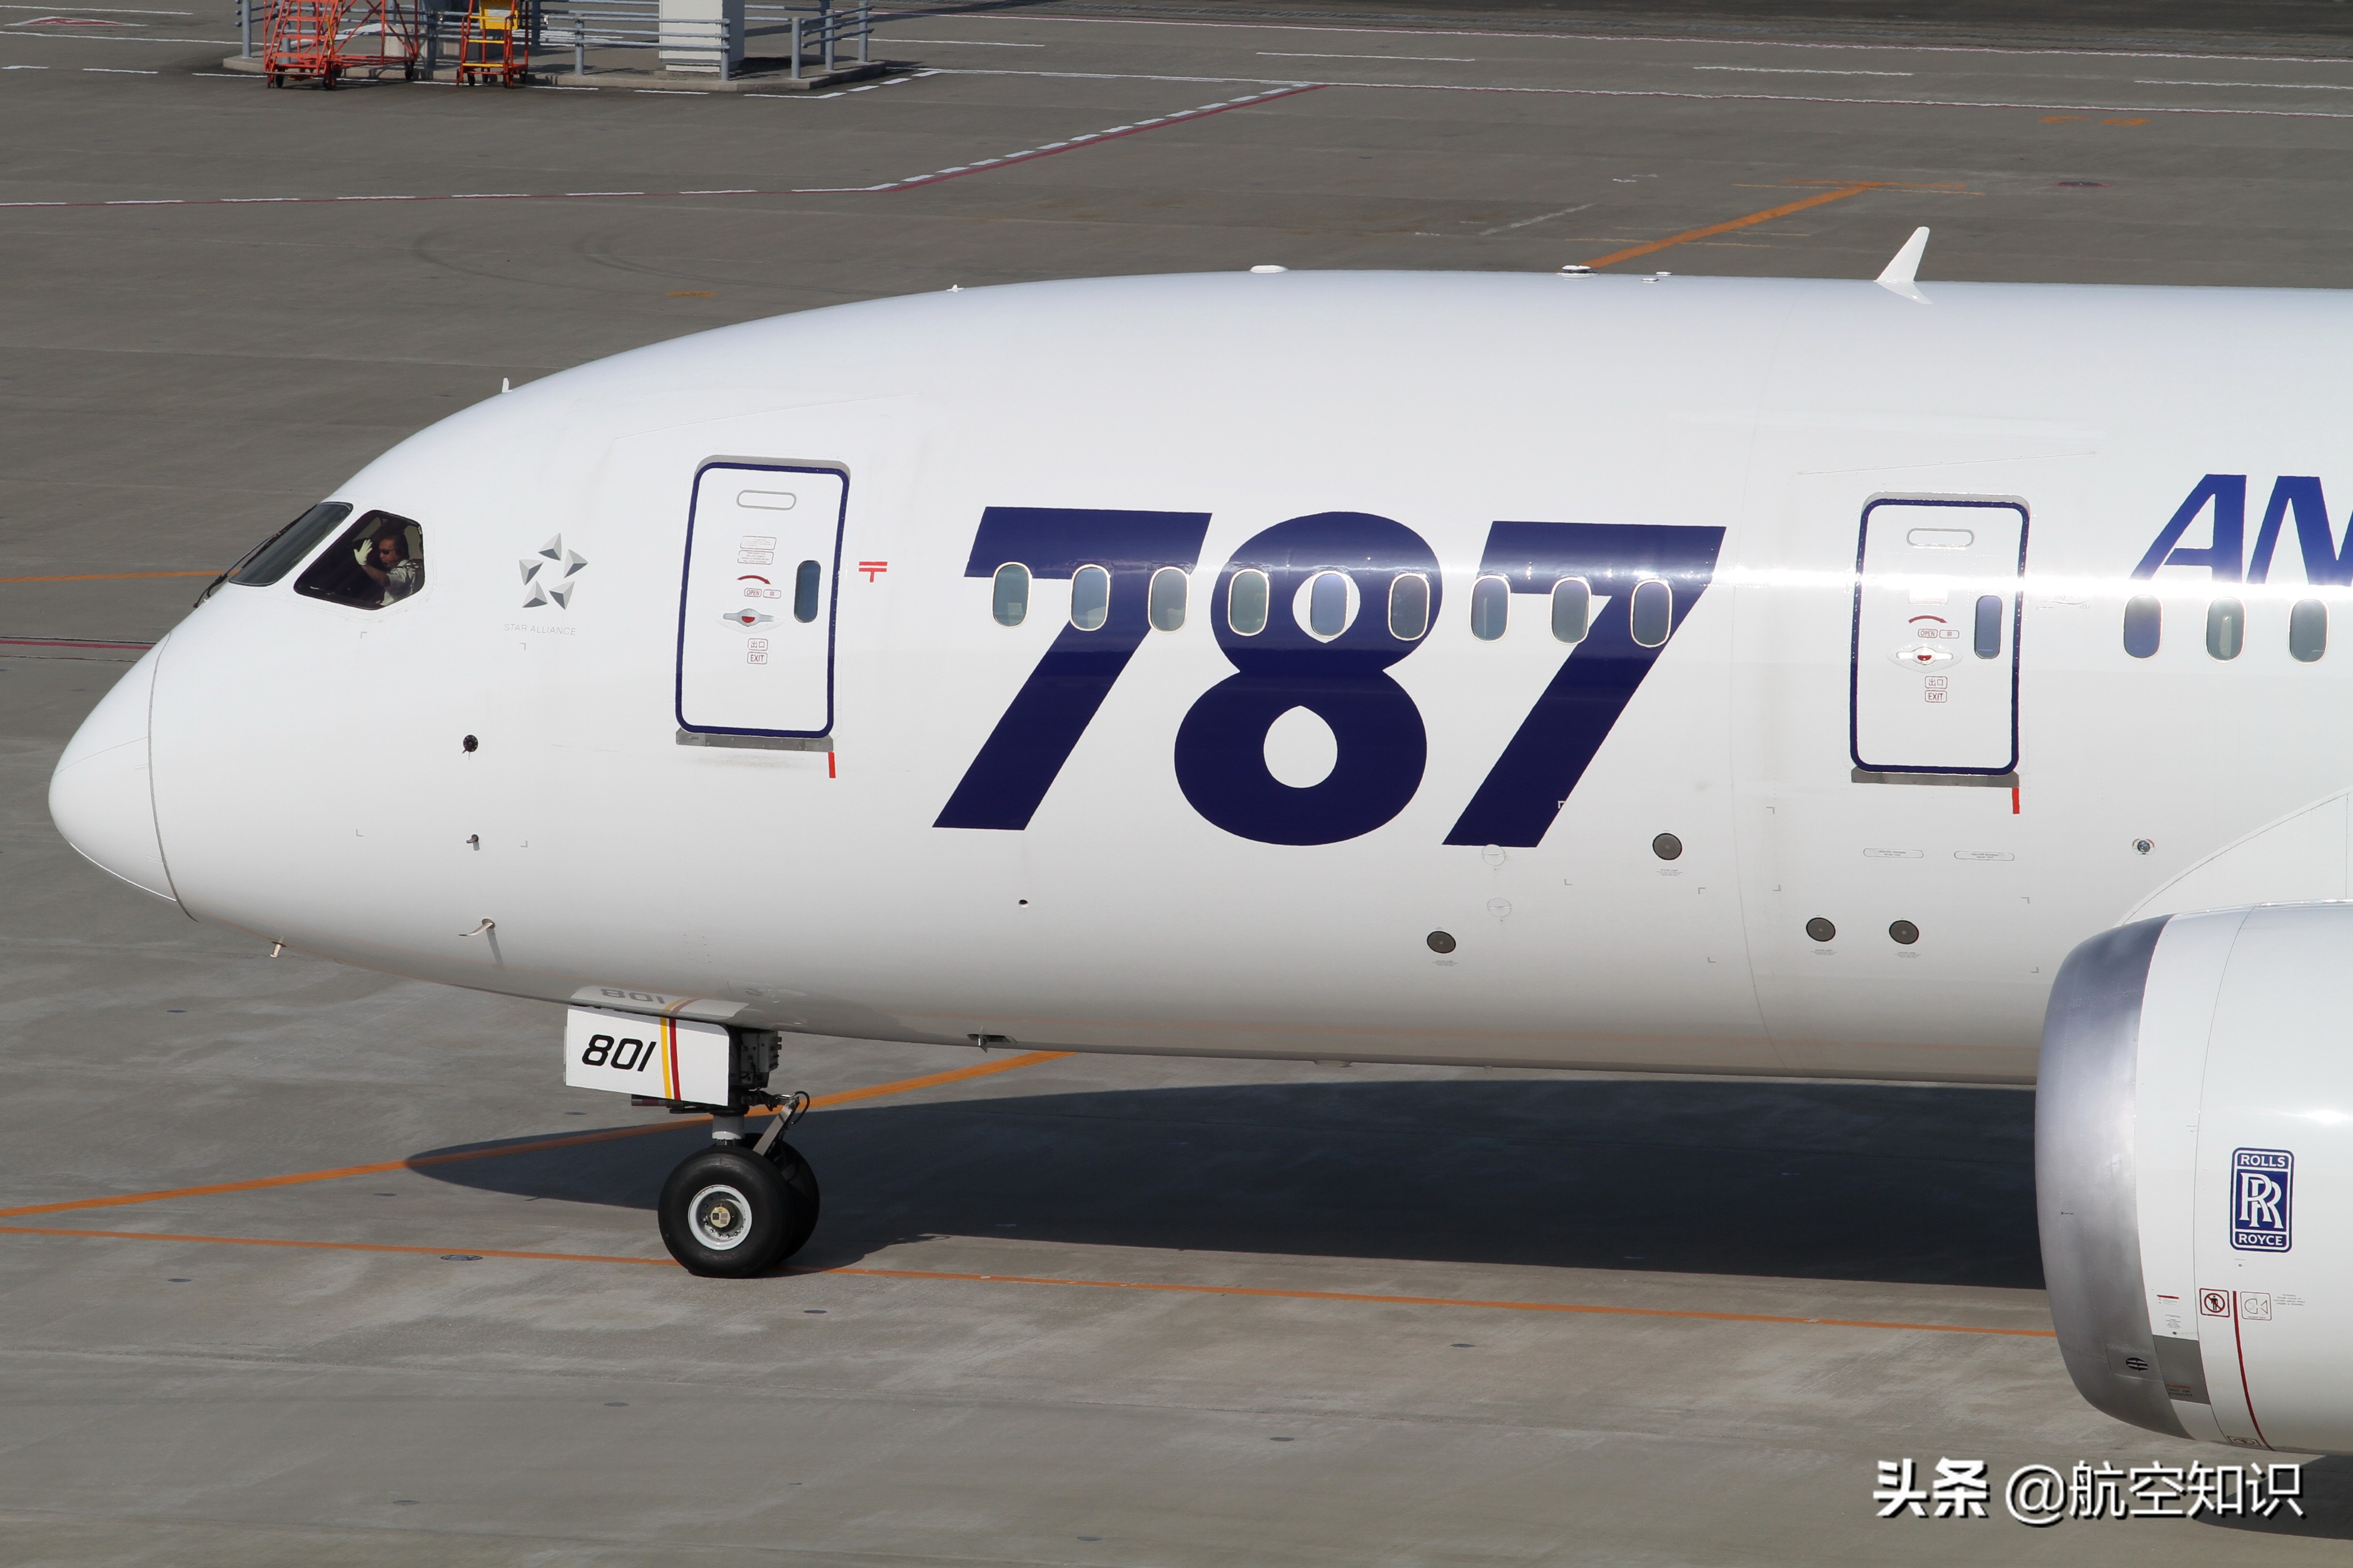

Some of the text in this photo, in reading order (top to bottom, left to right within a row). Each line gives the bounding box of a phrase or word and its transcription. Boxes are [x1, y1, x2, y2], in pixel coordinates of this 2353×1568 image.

[504, 623, 577, 635] STAR ALLIANCE
[933, 507, 1726, 847] 787
[1928, 678, 1944, 686] 出口
[582, 1034, 656, 1072] 801
[2240, 1154, 2286, 1168] ROLLS
[2239, 1172, 2285, 1229] RR
[2238, 1233, 2284, 1246] ROYCE
